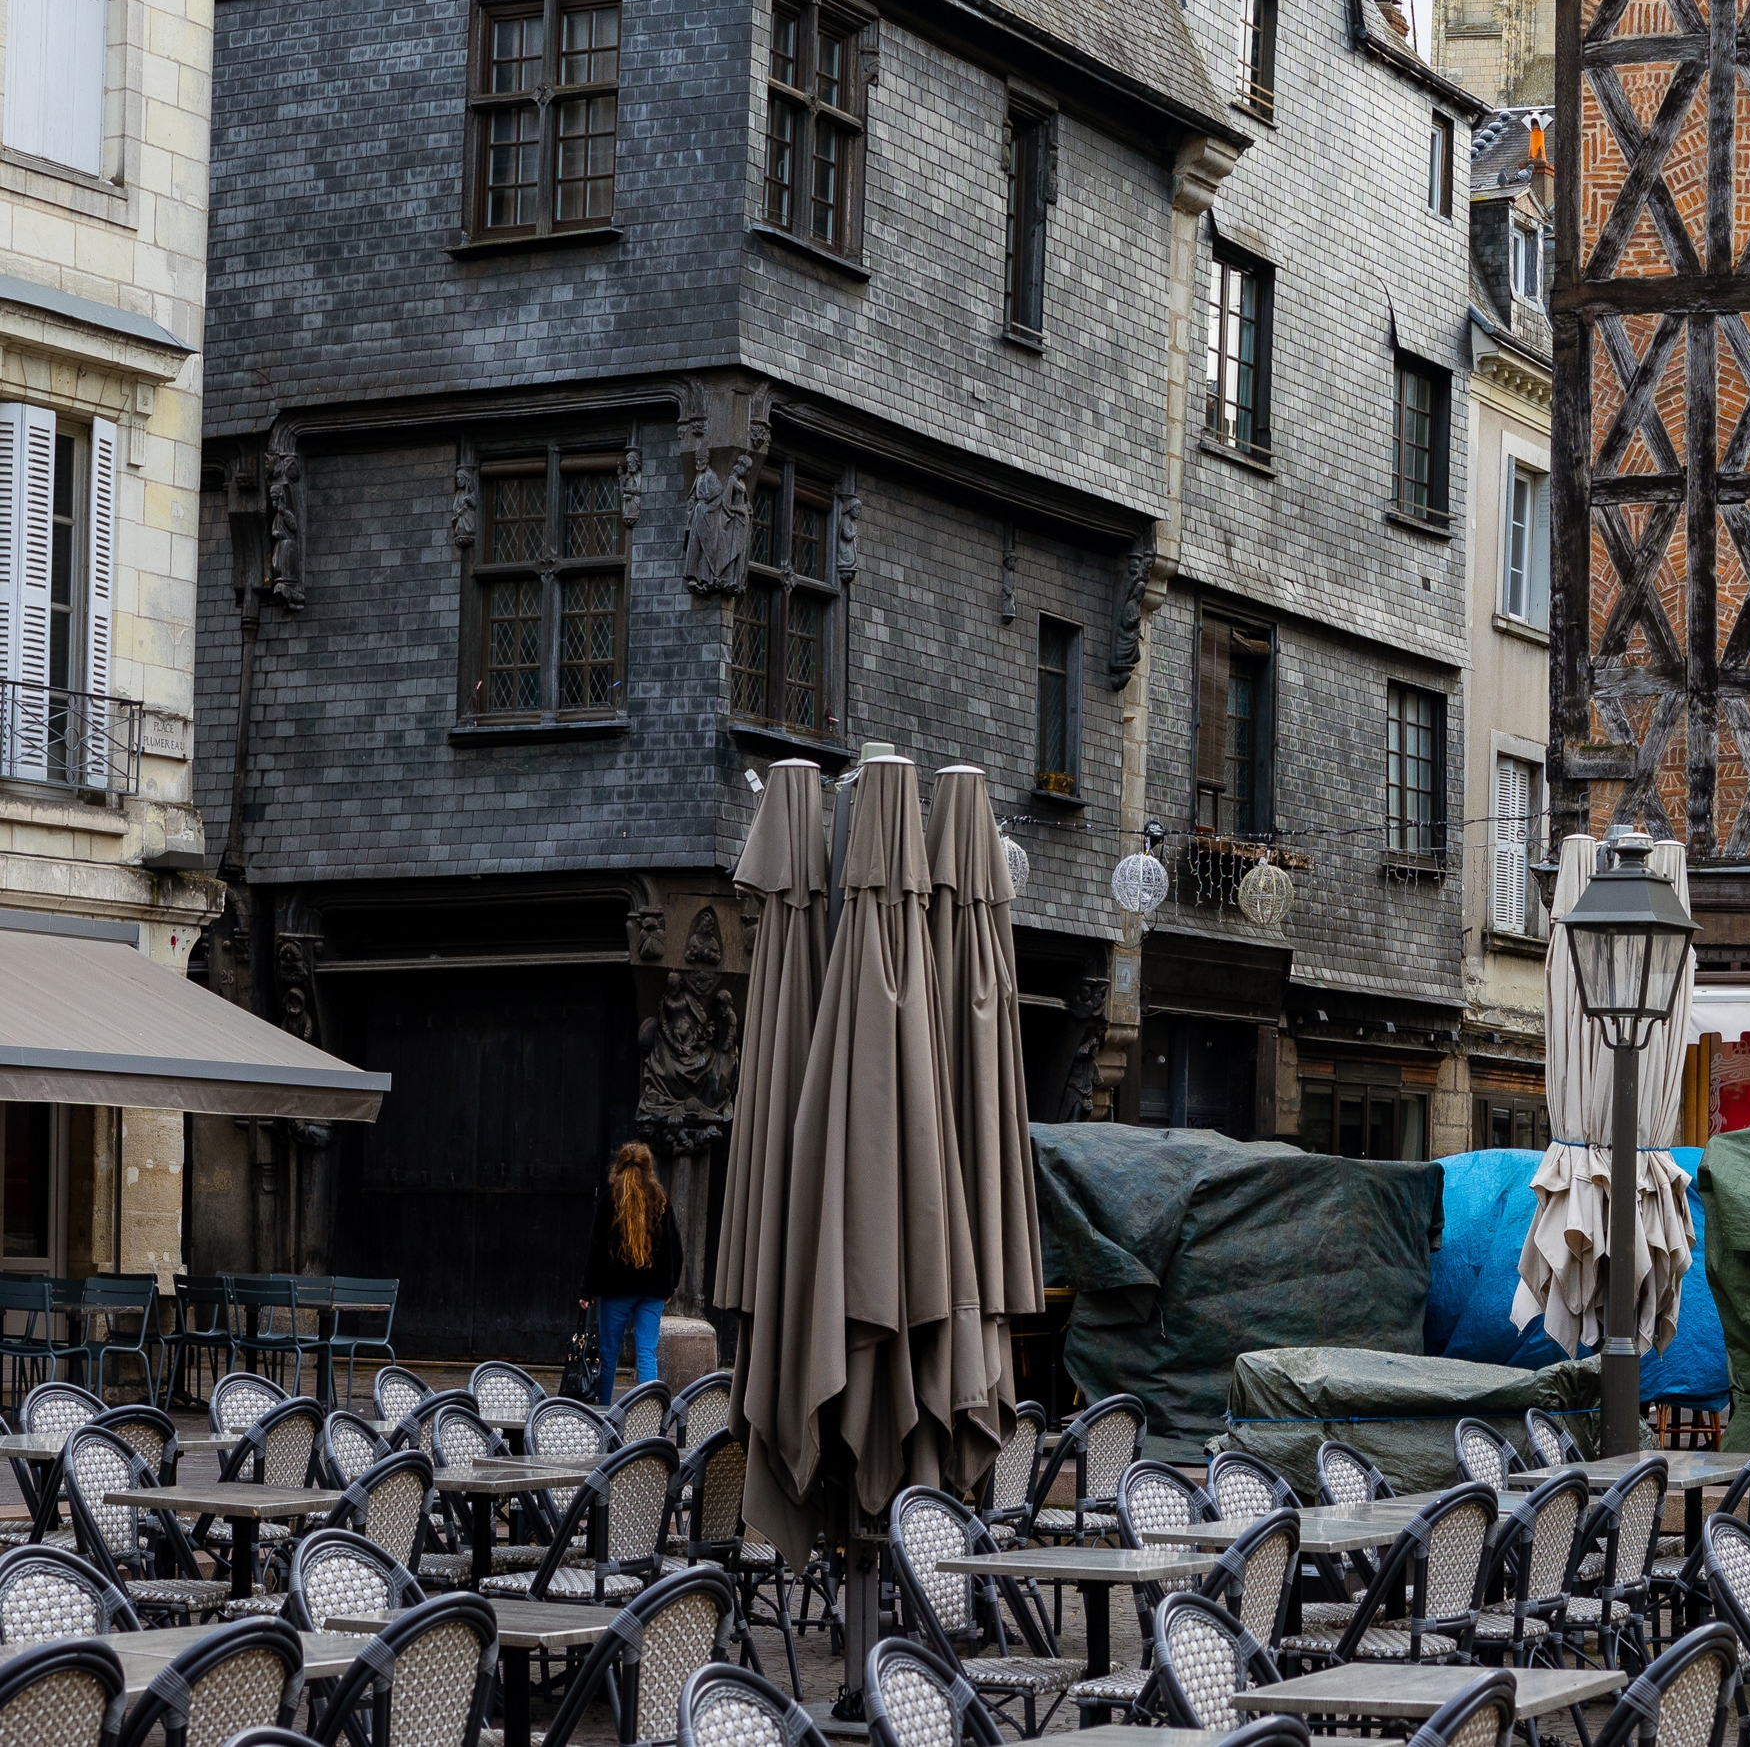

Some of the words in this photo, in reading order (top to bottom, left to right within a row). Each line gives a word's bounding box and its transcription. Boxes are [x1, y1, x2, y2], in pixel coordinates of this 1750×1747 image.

[153, 721, 174, 734] PLACE
[143, 735, 185, 751] PLUMEREAU
[221, 969, 235, 985] 26
